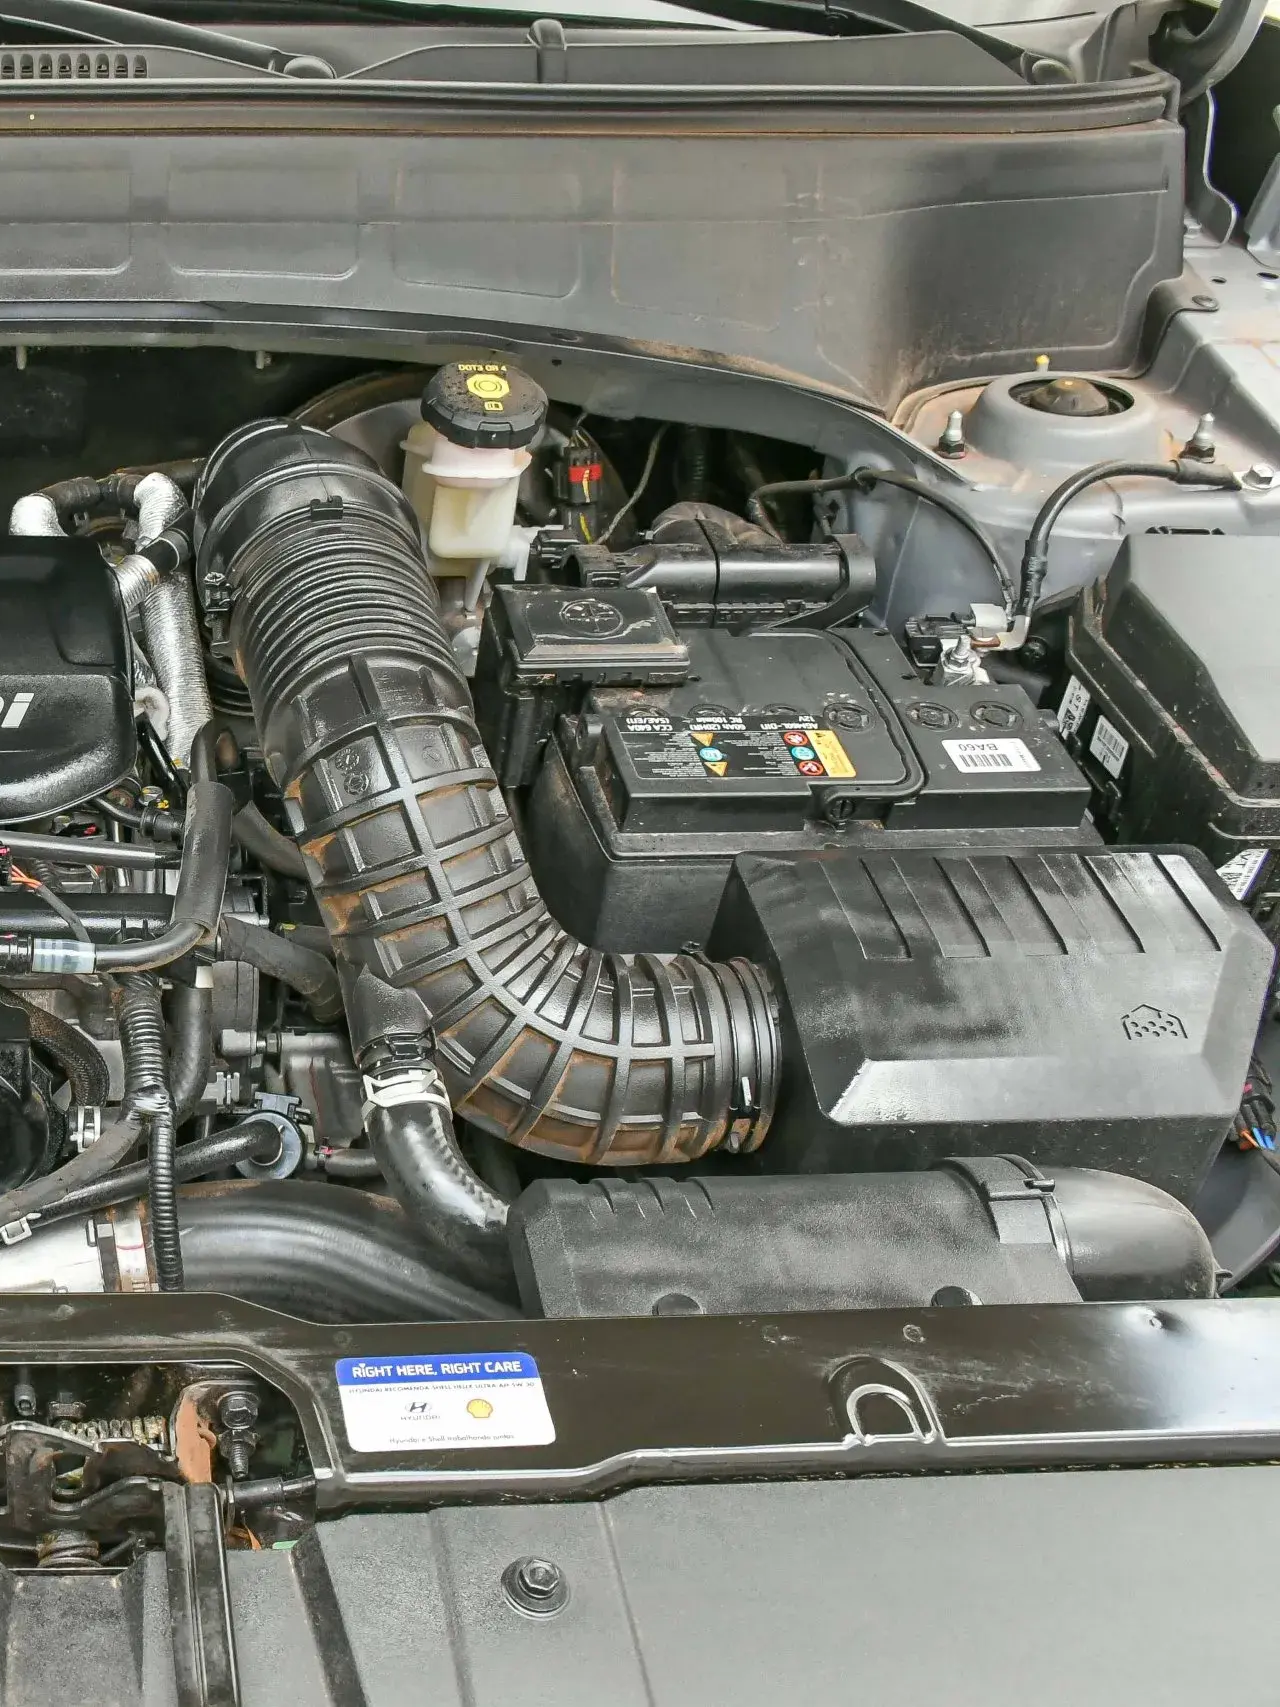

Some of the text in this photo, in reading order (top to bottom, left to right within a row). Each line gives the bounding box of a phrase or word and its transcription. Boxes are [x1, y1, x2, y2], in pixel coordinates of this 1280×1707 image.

[458, 364, 484, 372] DOT3
[485, 364, 499, 372] OR
[958, 743, 999, 752] BA60
[396, 1363, 438, 1377] HERE,
[440, 1362, 482, 1375] RIGHT
[484, 1360, 523, 1373] CARE
